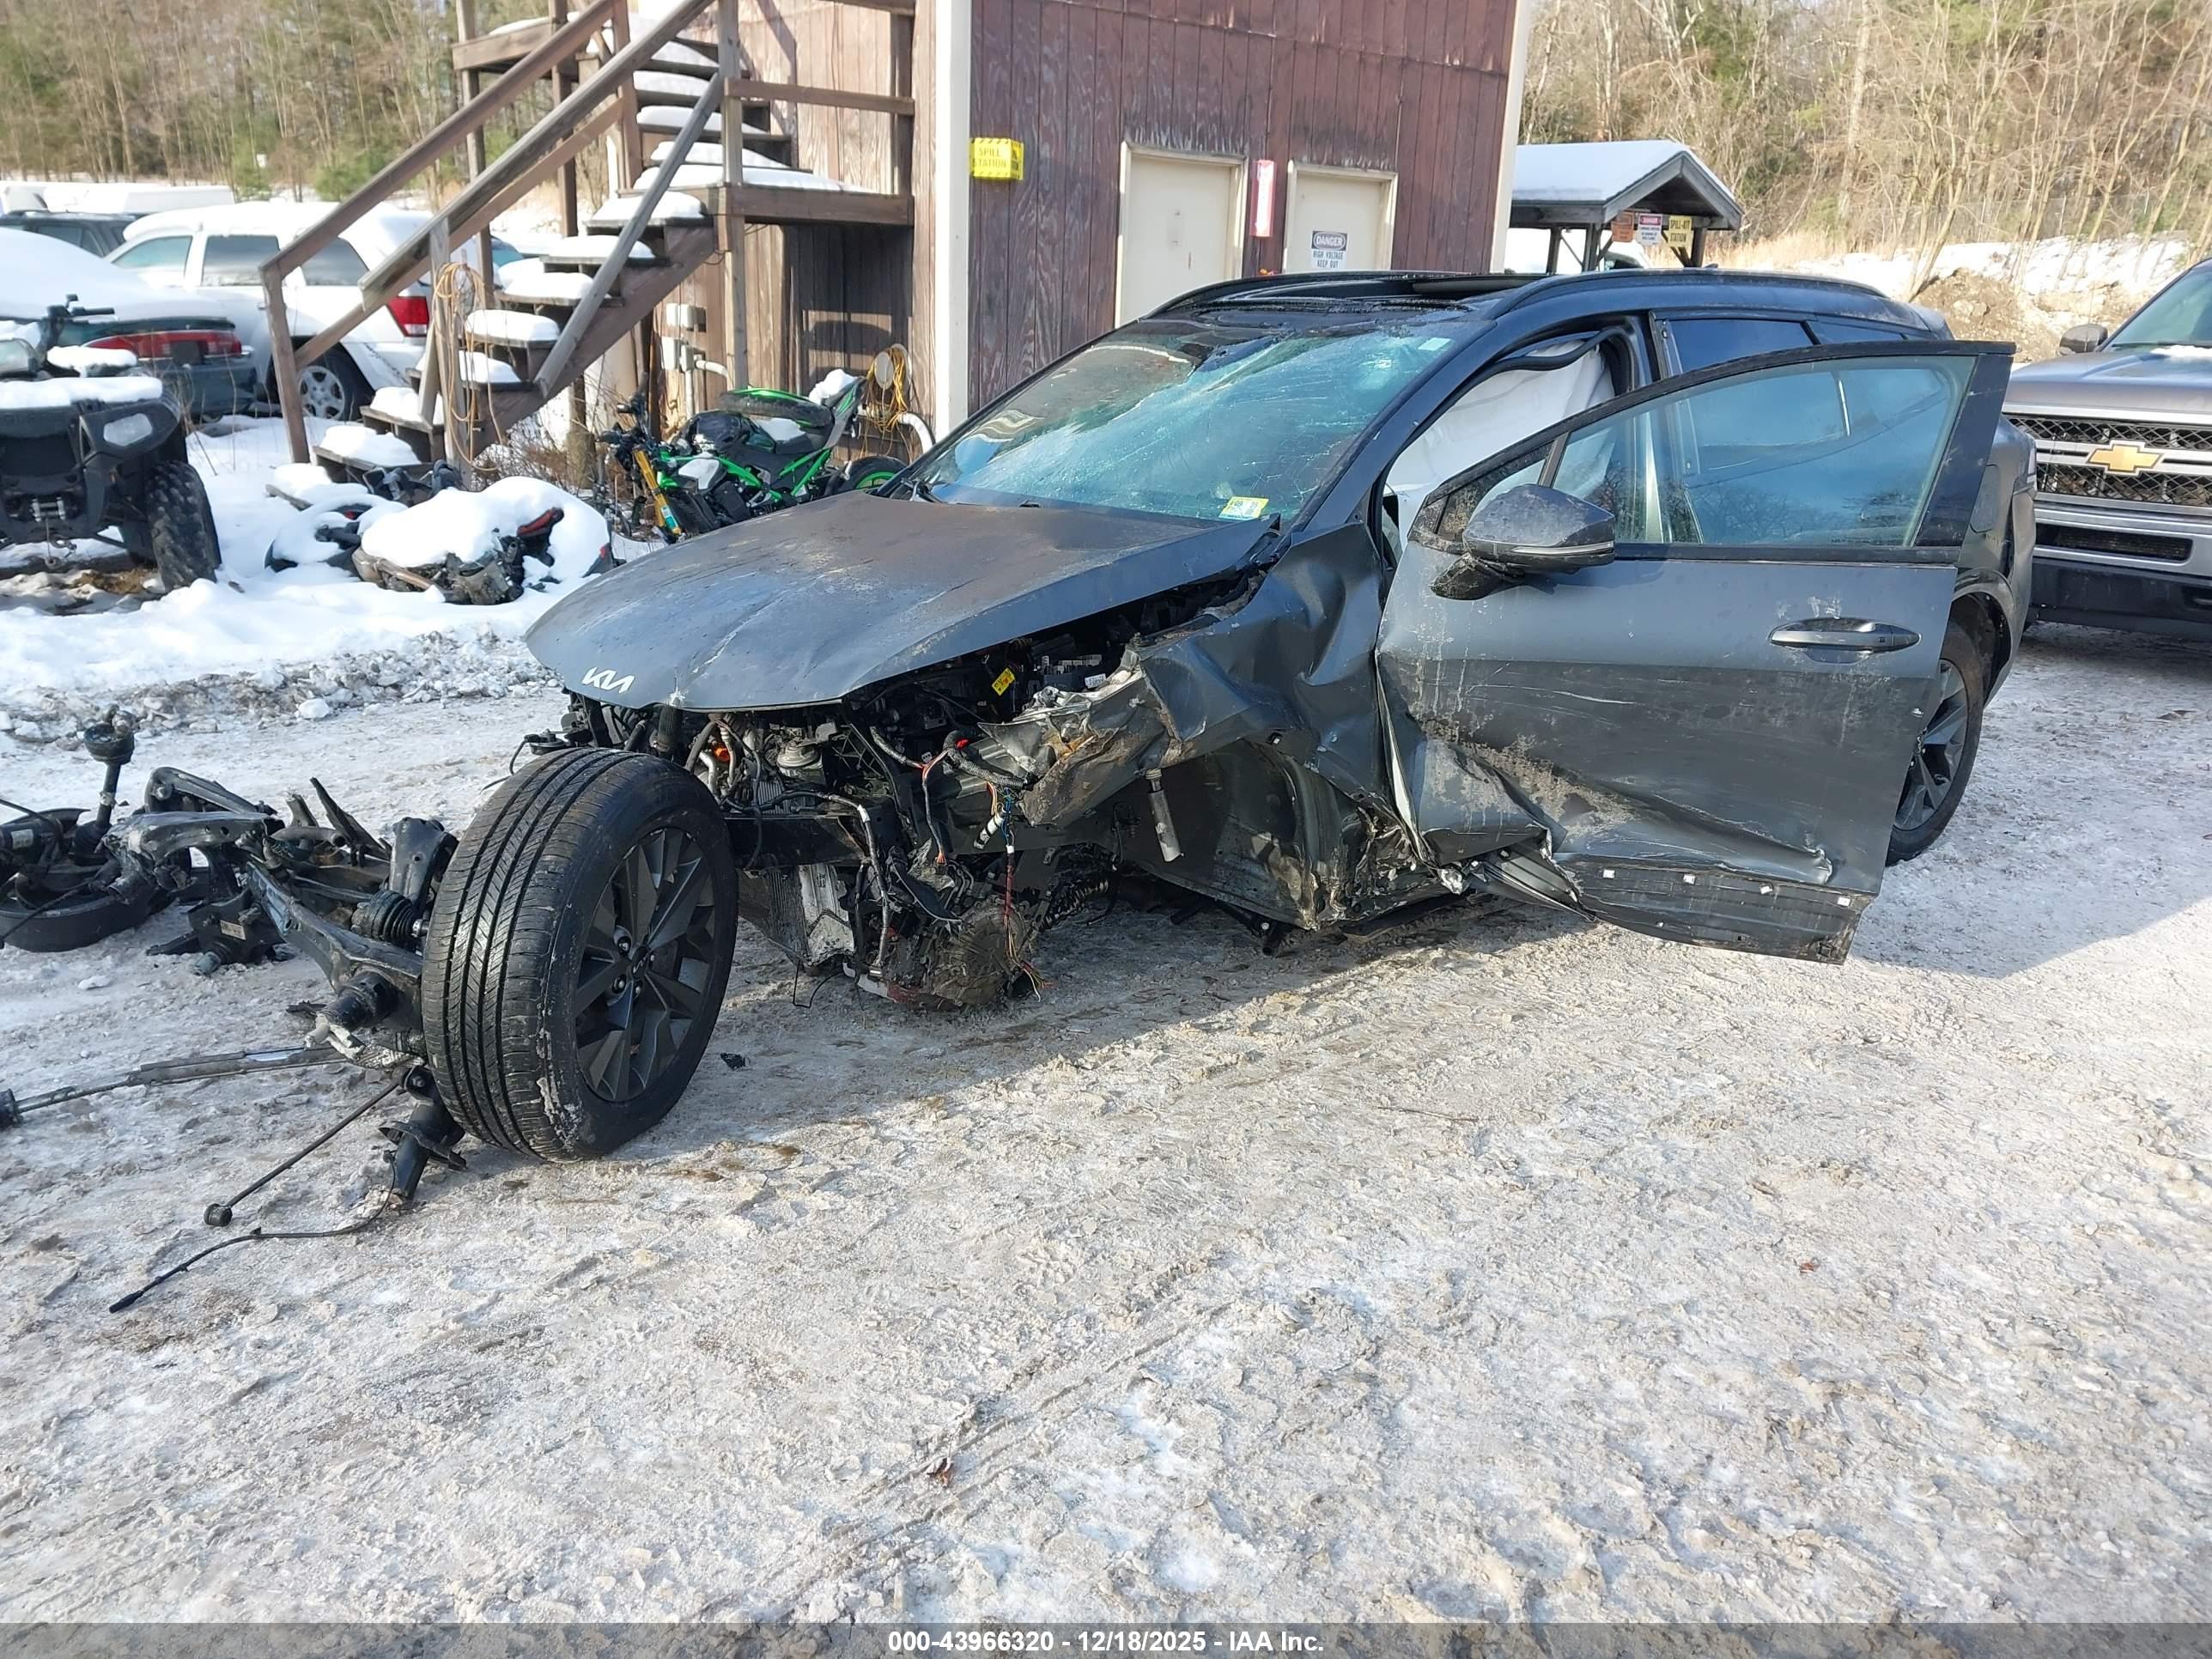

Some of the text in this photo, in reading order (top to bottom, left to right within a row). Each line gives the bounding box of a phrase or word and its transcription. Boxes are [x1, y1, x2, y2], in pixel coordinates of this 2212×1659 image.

[978, 147, 1000, 157] SPILL
[972, 158, 1006, 168] STATION
[1316, 235, 1343, 246] DANGER
[1313, 250, 1344, 260] HIGH VOLTAGE
[1317, 259, 1339, 269] KEEP OUT
[581, 666, 635, 694] KIA
